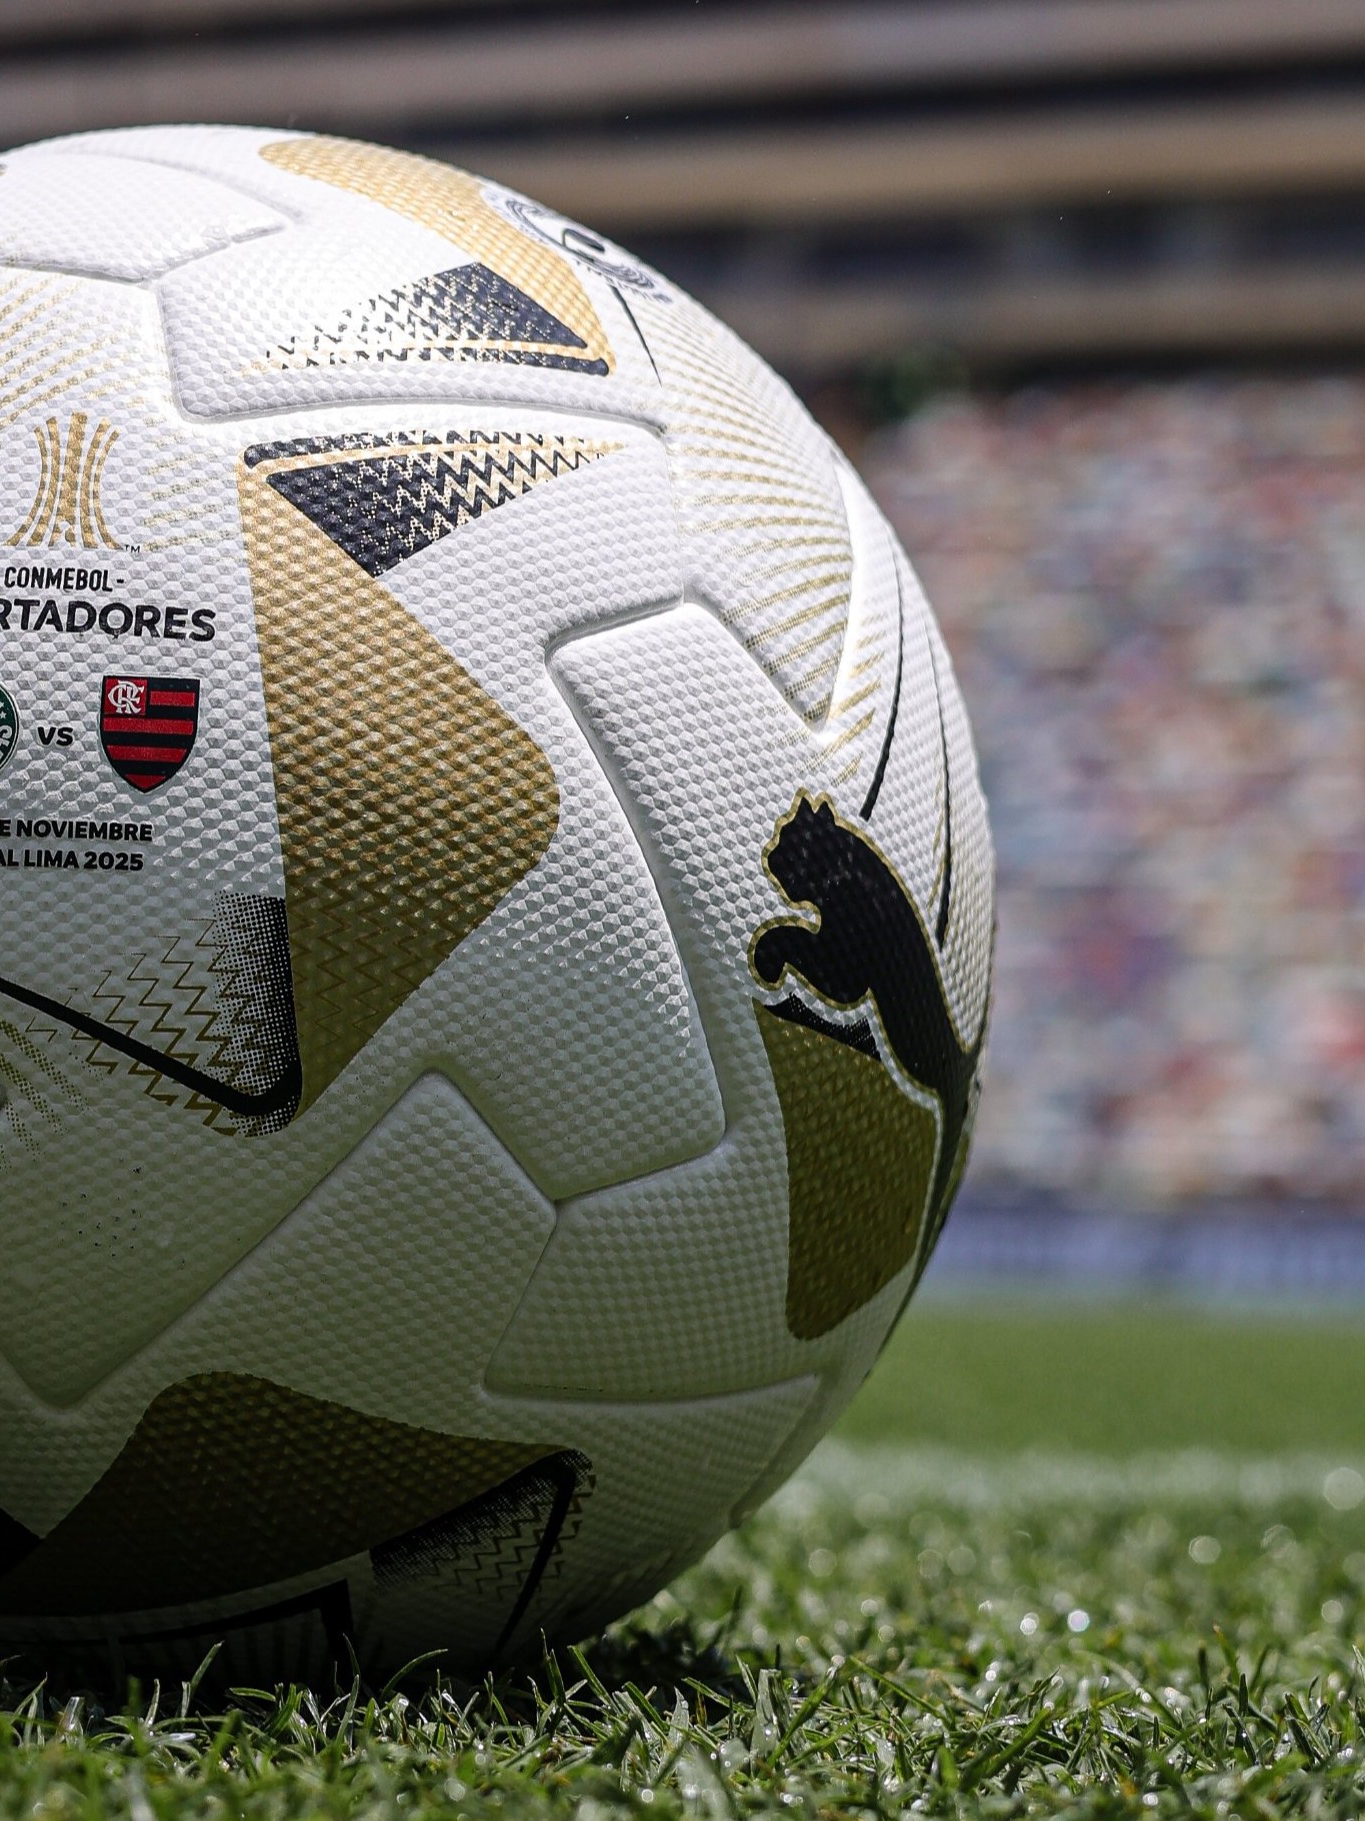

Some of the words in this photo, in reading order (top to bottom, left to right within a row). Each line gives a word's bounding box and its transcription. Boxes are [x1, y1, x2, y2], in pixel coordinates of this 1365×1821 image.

[17, 820, 153, 842] NOVIEMBRE
[24, 849, 80, 869] LIMA
[84, 851, 144, 871] 2025
